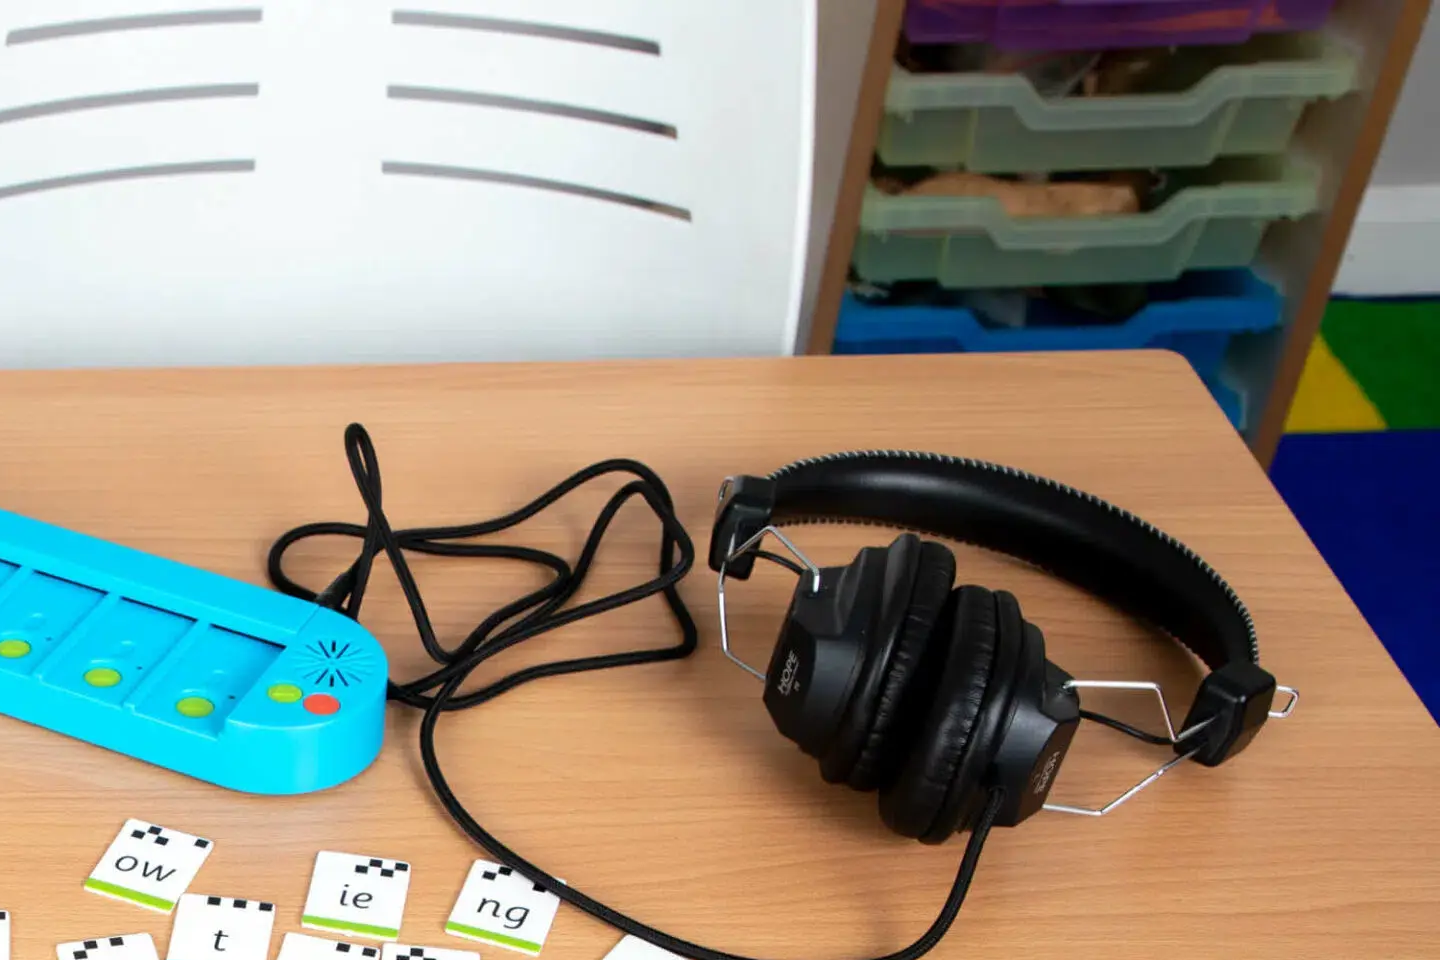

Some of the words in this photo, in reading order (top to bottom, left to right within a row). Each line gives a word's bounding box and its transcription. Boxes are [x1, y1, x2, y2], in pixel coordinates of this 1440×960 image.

[115, 855, 176, 882] ow
[339, 883, 373, 909] ie
[477, 898, 530, 930] ng
[214, 929, 229, 952] t
